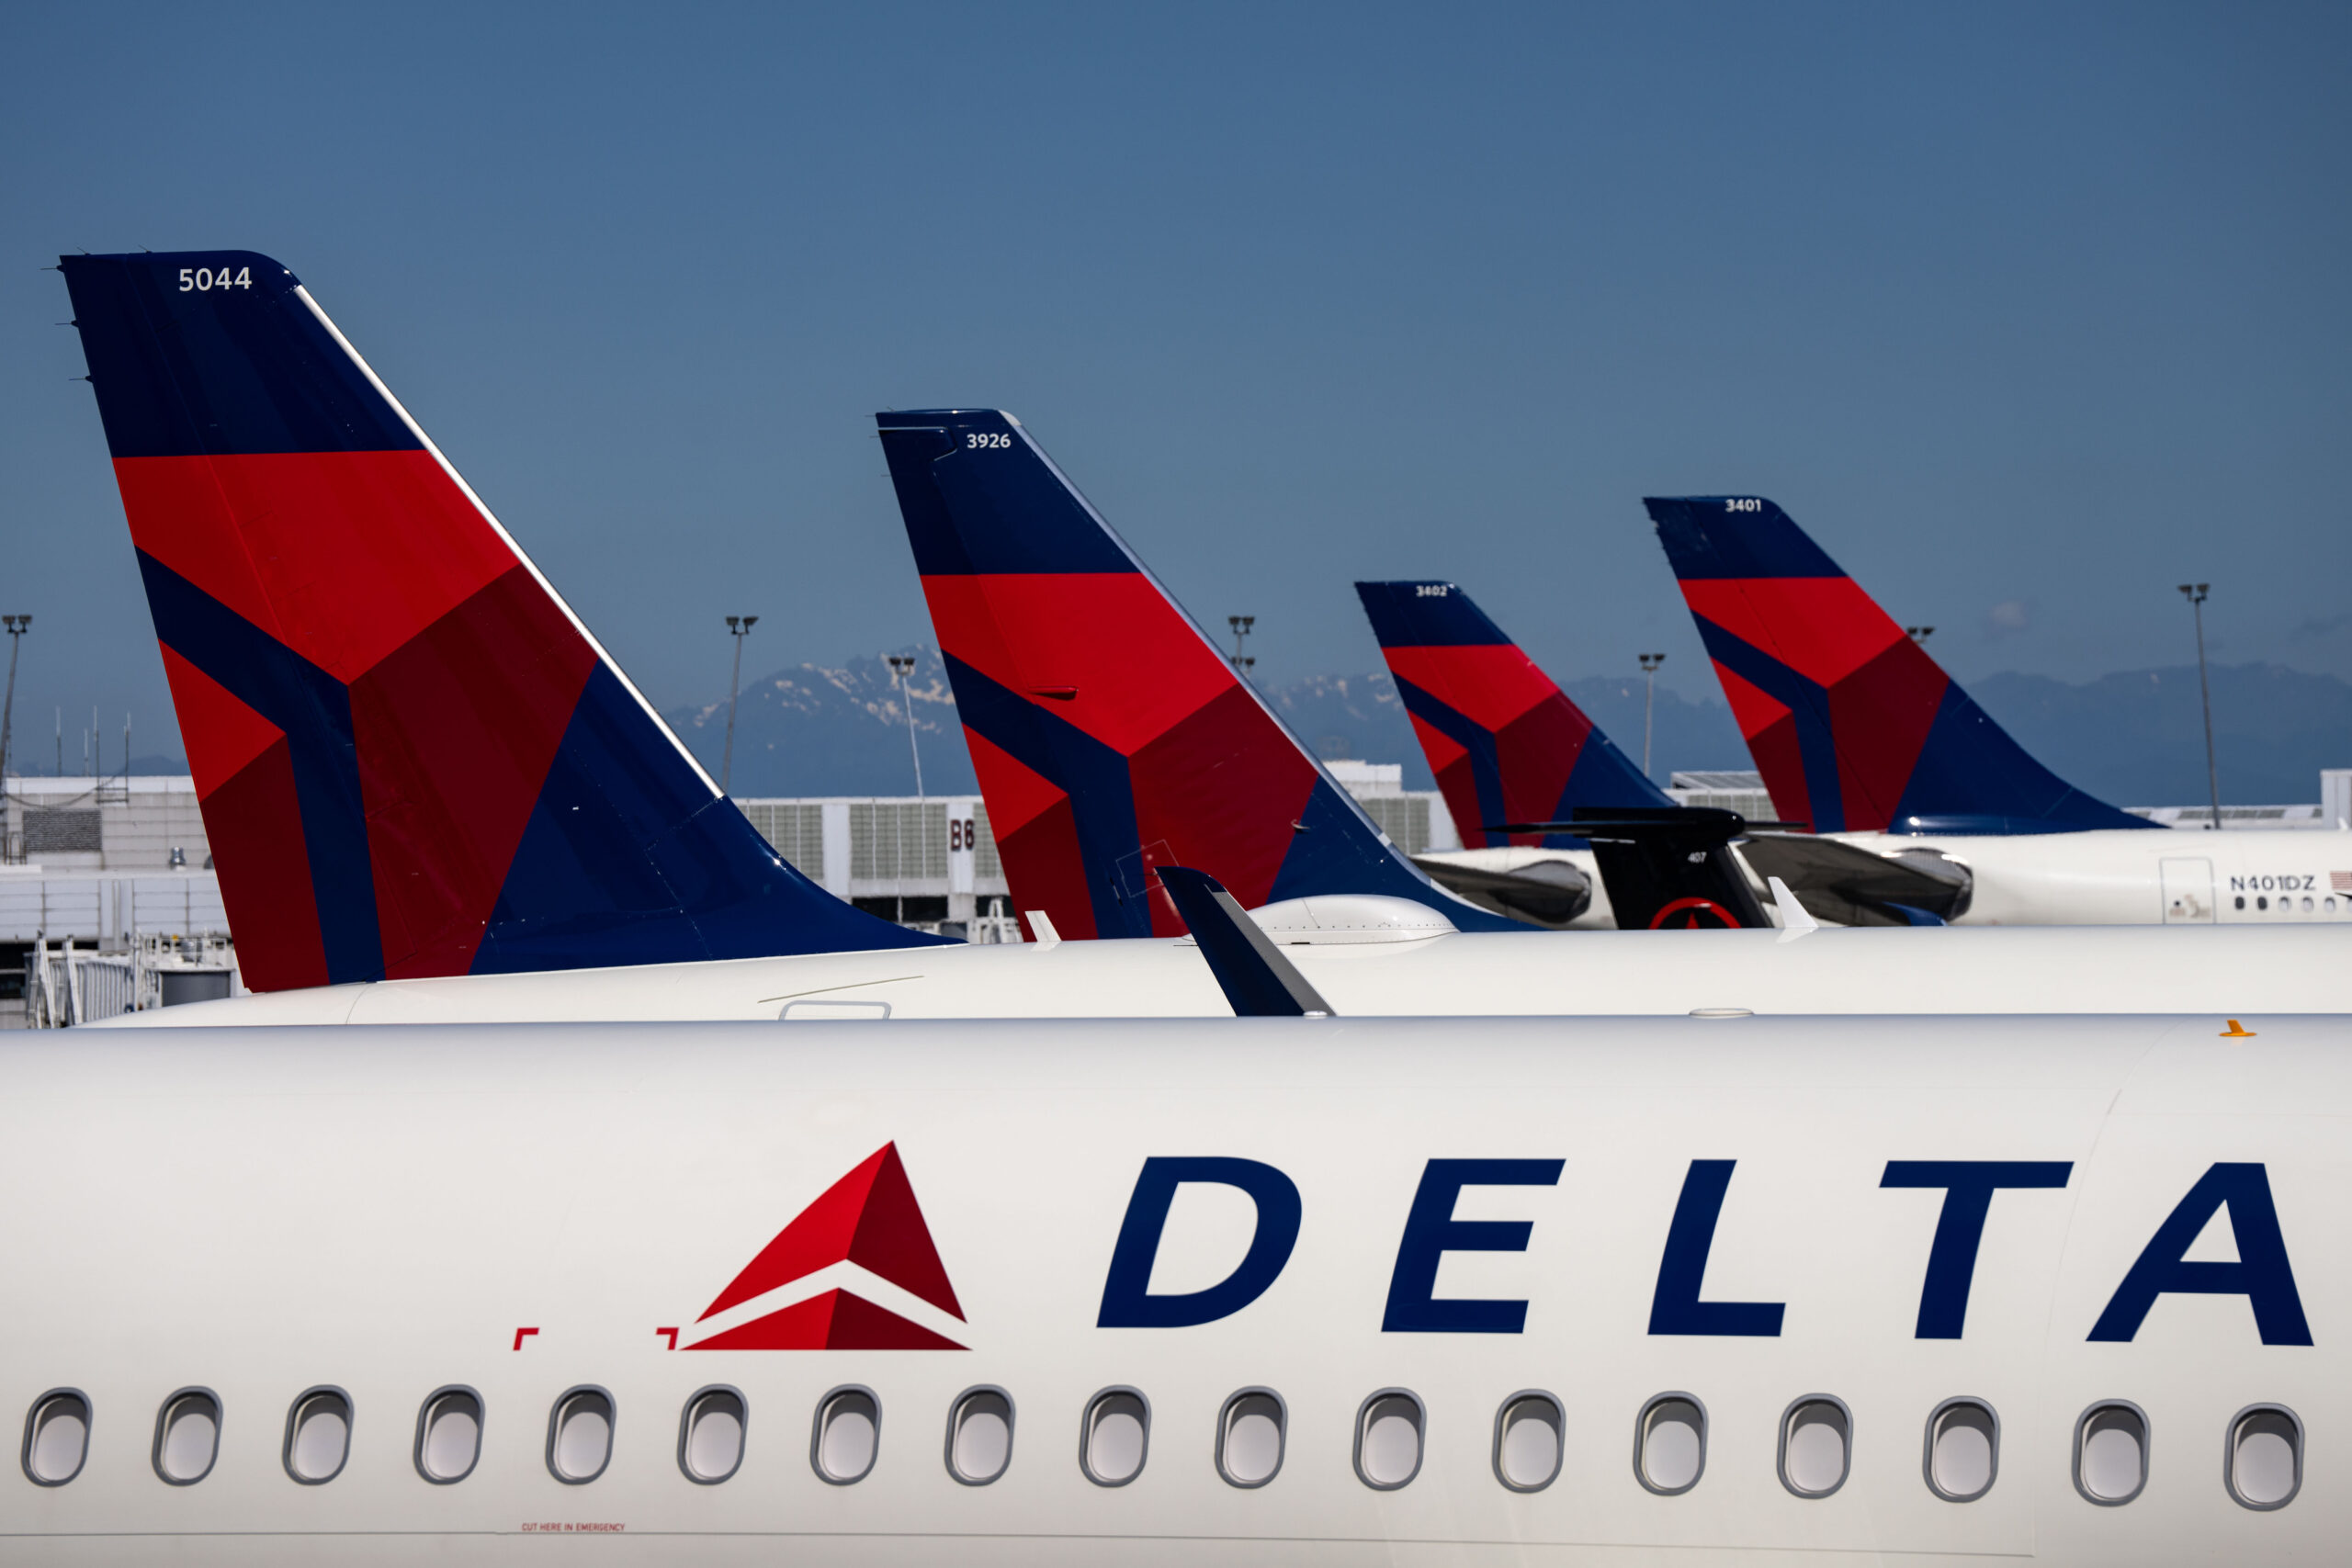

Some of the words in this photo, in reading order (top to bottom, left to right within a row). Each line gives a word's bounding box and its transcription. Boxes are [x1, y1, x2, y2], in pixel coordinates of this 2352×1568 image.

[179, 266, 253, 292] 5044
[967, 433, 1012, 449] 3926
[1725, 498, 1762, 513] 3401
[1416, 584, 1448, 597] 3402
[1687, 851, 1707, 863] 407
[2230, 874, 2315, 892] N401DZ
[1096, 1156, 2314, 1347] DELTA
[521, 1522, 537, 1531] CUT
[539, 1522, 561, 1531] HERE
[564, 1522, 573, 1531] IN
[575, 1522, 625, 1531] EMERGENCY
